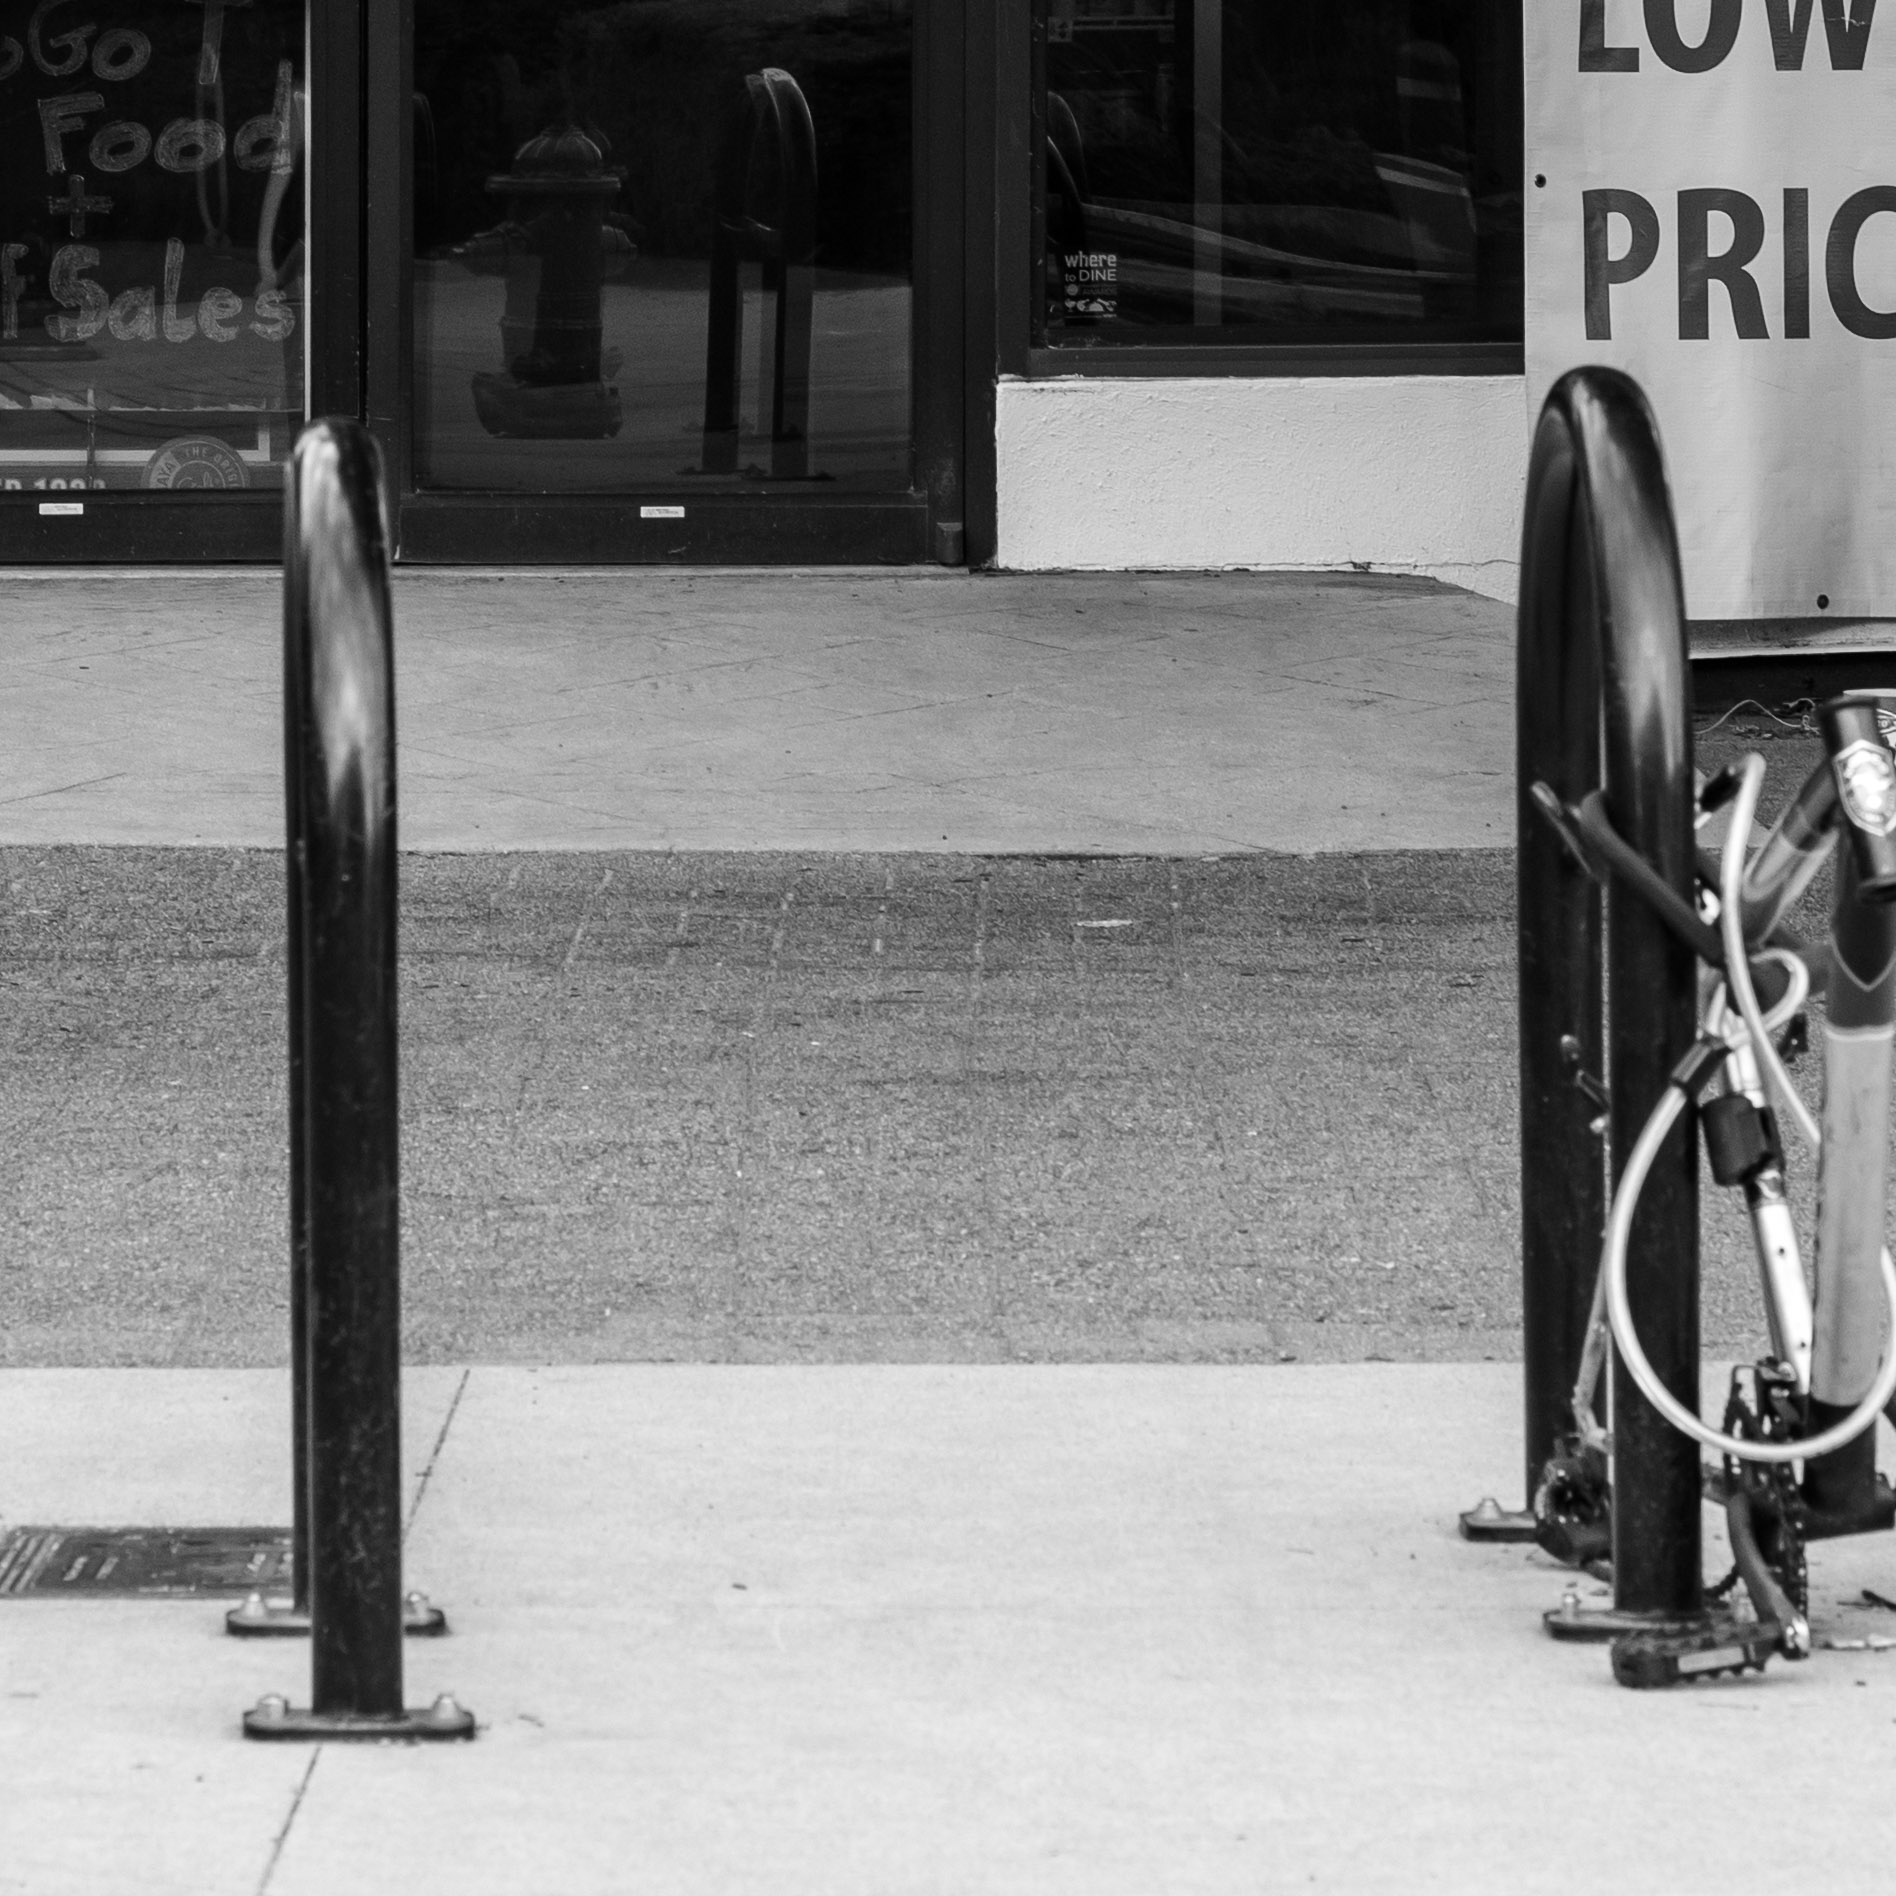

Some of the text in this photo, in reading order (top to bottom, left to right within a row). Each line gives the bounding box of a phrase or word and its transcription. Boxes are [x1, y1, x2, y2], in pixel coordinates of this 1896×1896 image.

[37, 59, 294, 175] Food
[1064, 249, 1118, 269] where
[1064, 268, 1118, 283] to DINE
